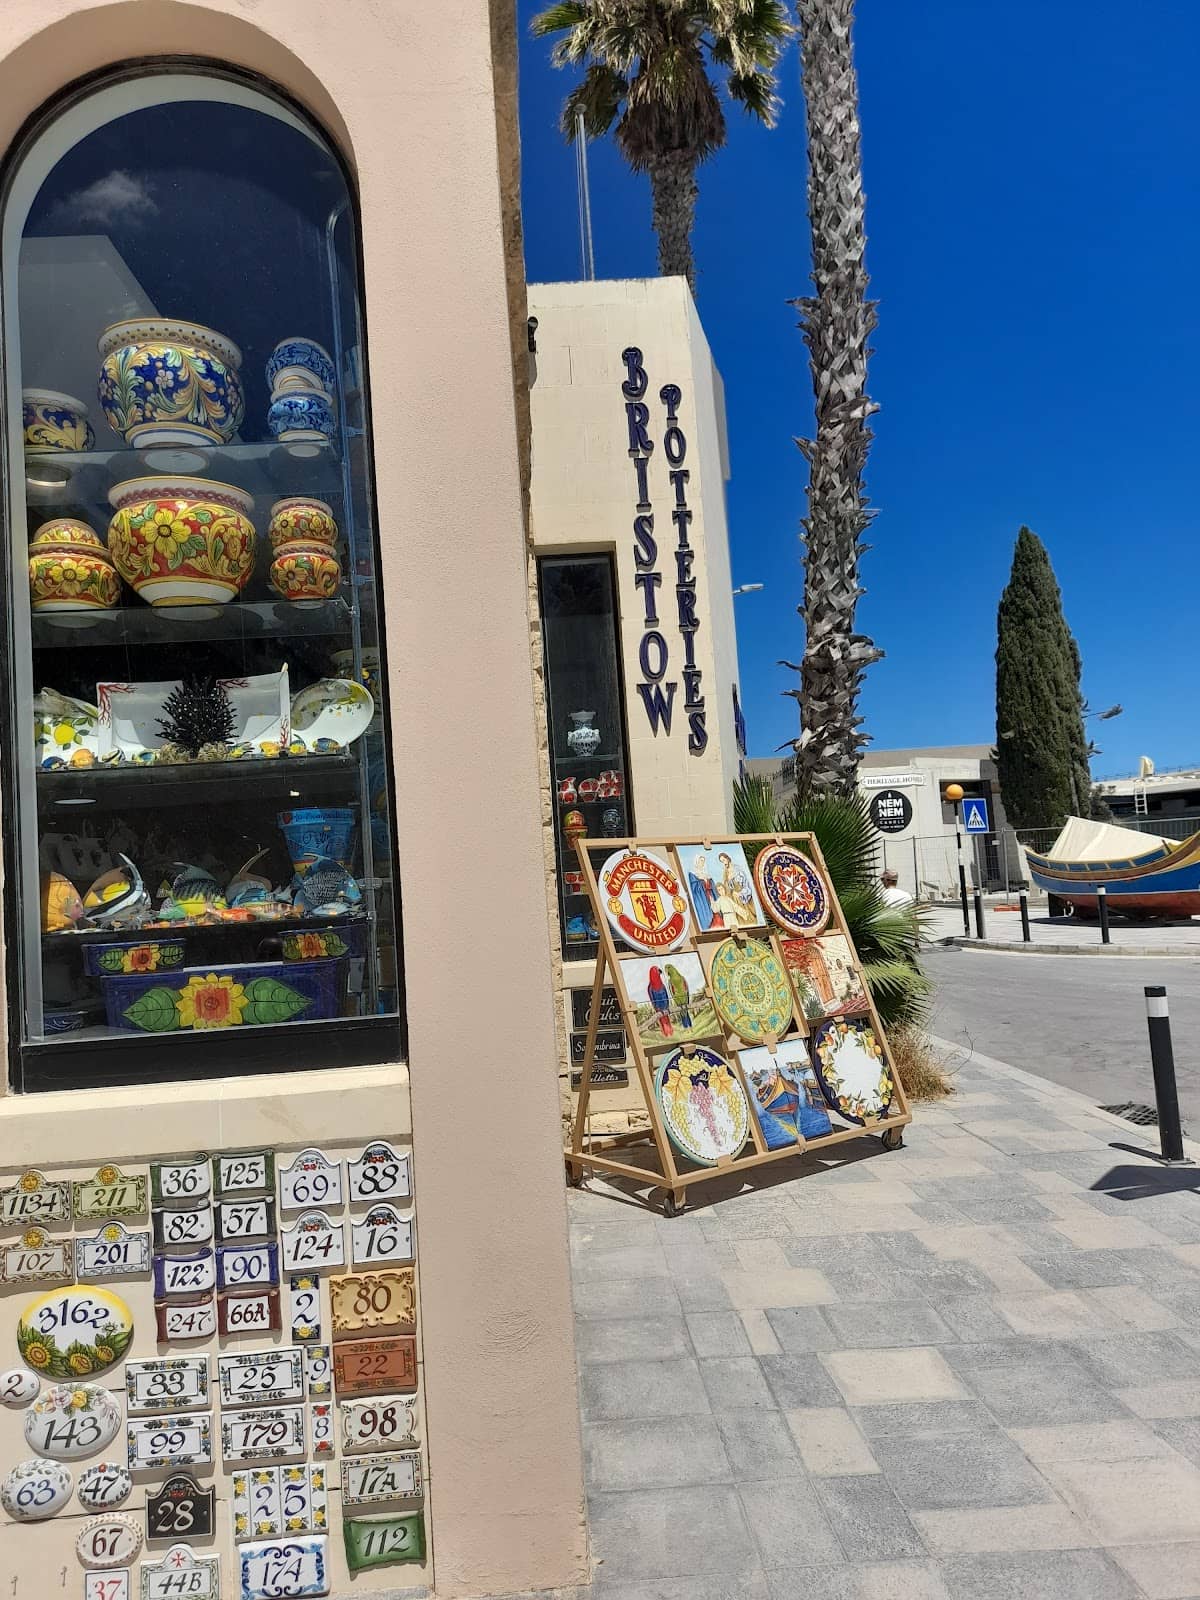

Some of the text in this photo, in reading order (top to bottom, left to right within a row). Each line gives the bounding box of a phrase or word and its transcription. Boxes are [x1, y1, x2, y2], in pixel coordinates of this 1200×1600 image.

[621, 346, 677, 738] BRISTOW
[660, 384, 708, 753] POTTERIES
[878, 798, 903, 808] NEM
[879, 808, 904, 817] NEM
[611, 860, 673, 891] MANCHESTER
[634, 926, 677, 944] UNITED
[166, 1169, 197, 1194] 36
[225, 1162, 260, 1187] 125
[358, 1164, 399, 1195] 88
[90, 1187, 128, 1207] 211
[293, 1175, 329, 1202] 69
[9, 1193, 57, 1216] 1134
[168, 1214, 199, 1241] 82
[226, 1207, 260, 1234] 57
[94, 1244, 129, 1265] 201
[293, 1234, 334, 1261] 124
[365, 1227, 398, 1257] 16
[17, 1253, 55, 1271] 107
[230, 1255, 262, 1282] 90
[170, 1264, 205, 1287] 122
[293, 1293, 316, 1324] 2
[353, 1286, 392, 1315] 80
[39, 1299, 109, 1334] 3162
[169, 1311, 210, 1333] 247
[230, 1302, 266, 1325] 66A
[238, 1365, 279, 1389] 25
[311, 1359, 327, 1381] 9
[356, 1356, 388, 1376] 22
[4, 1373, 26, 1397] 2
[147, 1372, 184, 1396] 33
[44, 1417, 101, 1450] 143
[242, 1422, 288, 1447] 179
[315, 1417, 329, 1438] 8
[358, 1407, 397, 1437] 98
[151, 1431, 186, 1454] 99
[17, 1479, 56, 1506] 63
[85, 1476, 120, 1500] 47
[358, 1466, 398, 1495] 17A
[254, 1484, 306, 1517] 25
[156, 1500, 194, 1532] 28
[92, 1528, 124, 1557] 67
[365, 1527, 410, 1556] 112
[94, 1580, 122, 1600] 37
[158, 1571, 203, 1595] 44B
